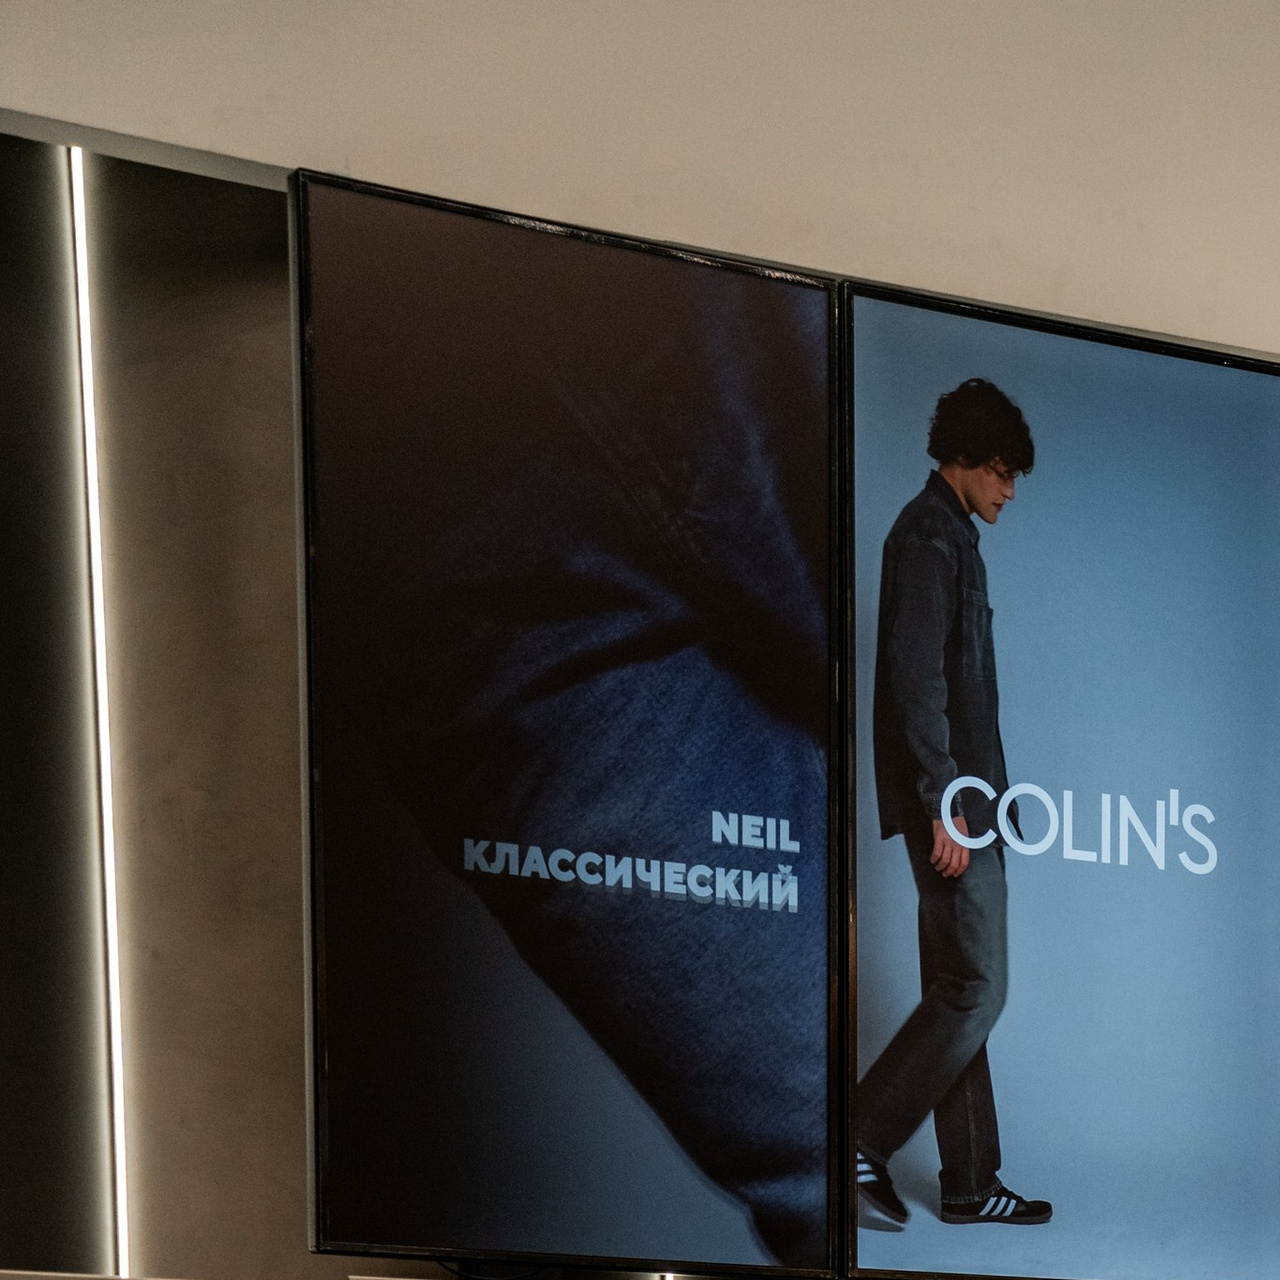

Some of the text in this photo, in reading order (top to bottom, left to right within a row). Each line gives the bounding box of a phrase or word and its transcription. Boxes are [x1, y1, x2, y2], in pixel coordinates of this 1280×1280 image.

[711, 811, 801, 853] NEIL
[940, 776, 1218, 875] COLIN'S
[463, 838, 799, 911] КЛАССИЧЕСКИЙ
